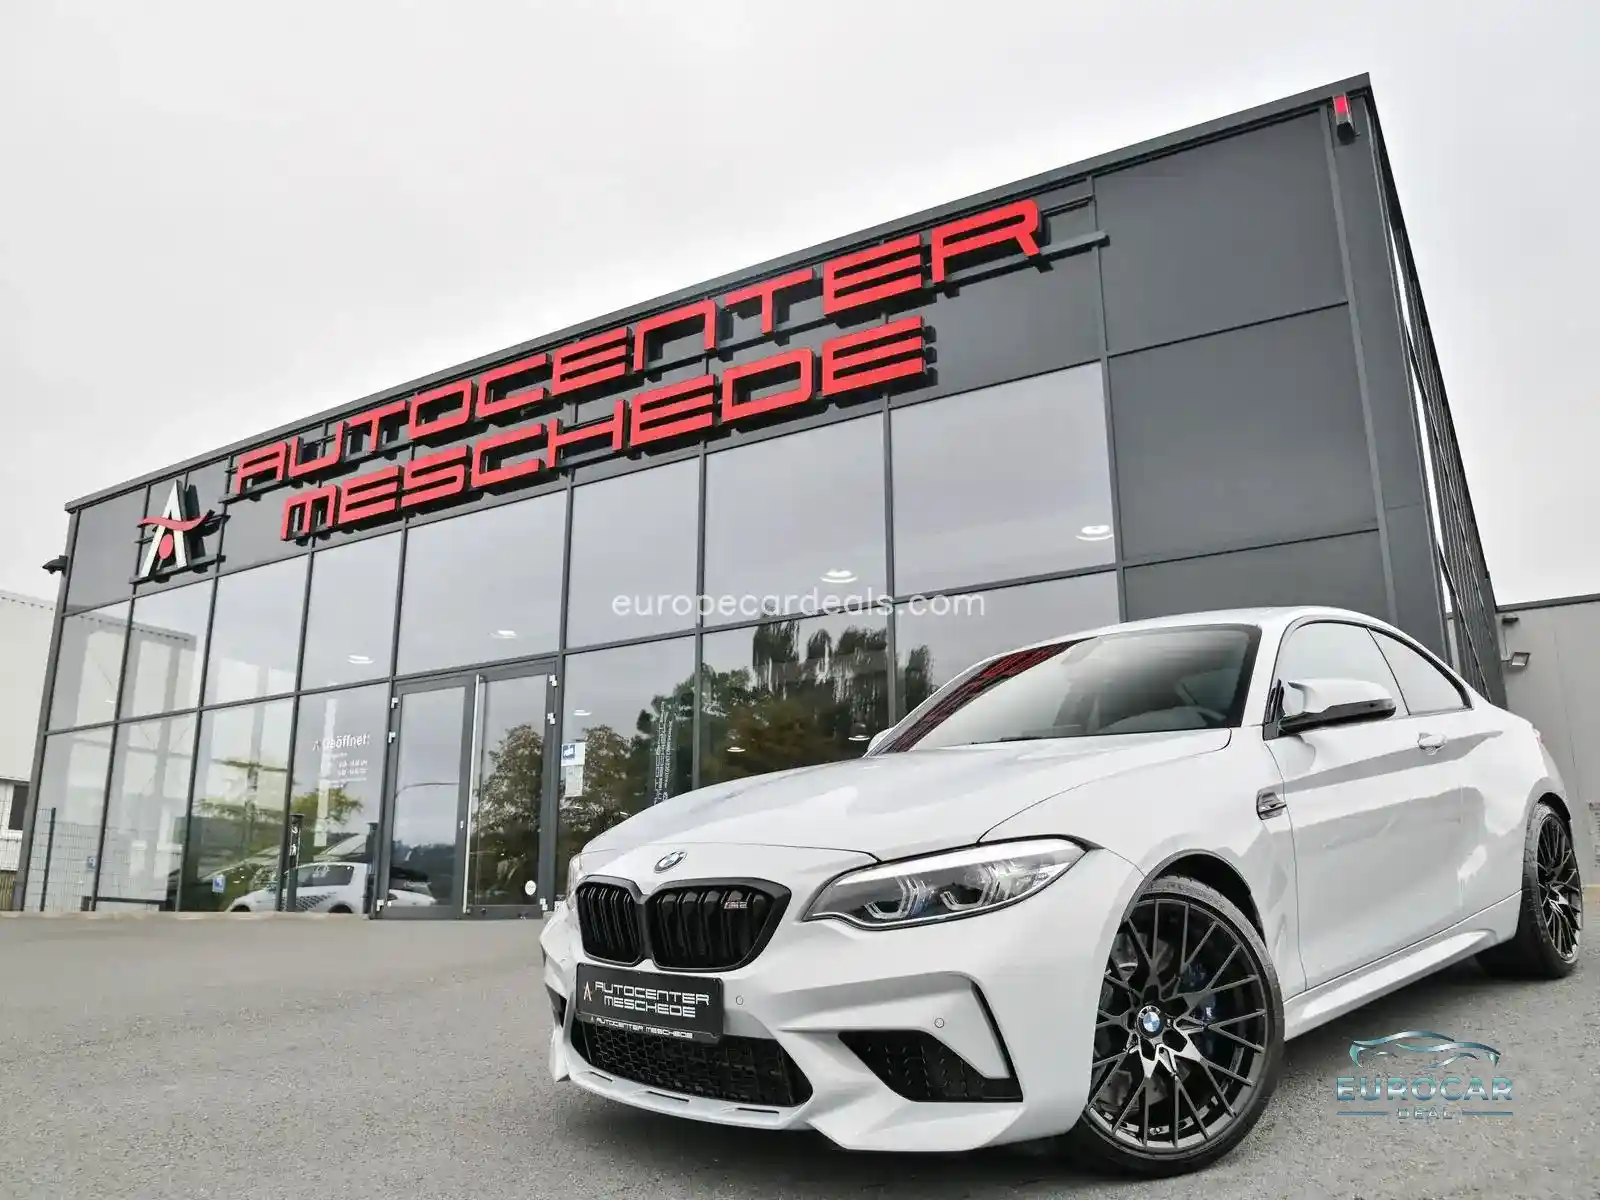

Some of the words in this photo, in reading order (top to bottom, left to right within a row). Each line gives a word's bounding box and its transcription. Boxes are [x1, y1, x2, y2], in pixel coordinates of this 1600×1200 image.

[232, 198, 1042, 496] AUTOCENTER
[280, 315, 925, 542] MESCHEDE
[594, 981, 710, 1006] AUTOCENTER
[604, 995, 696, 1018] MESCHEDE
